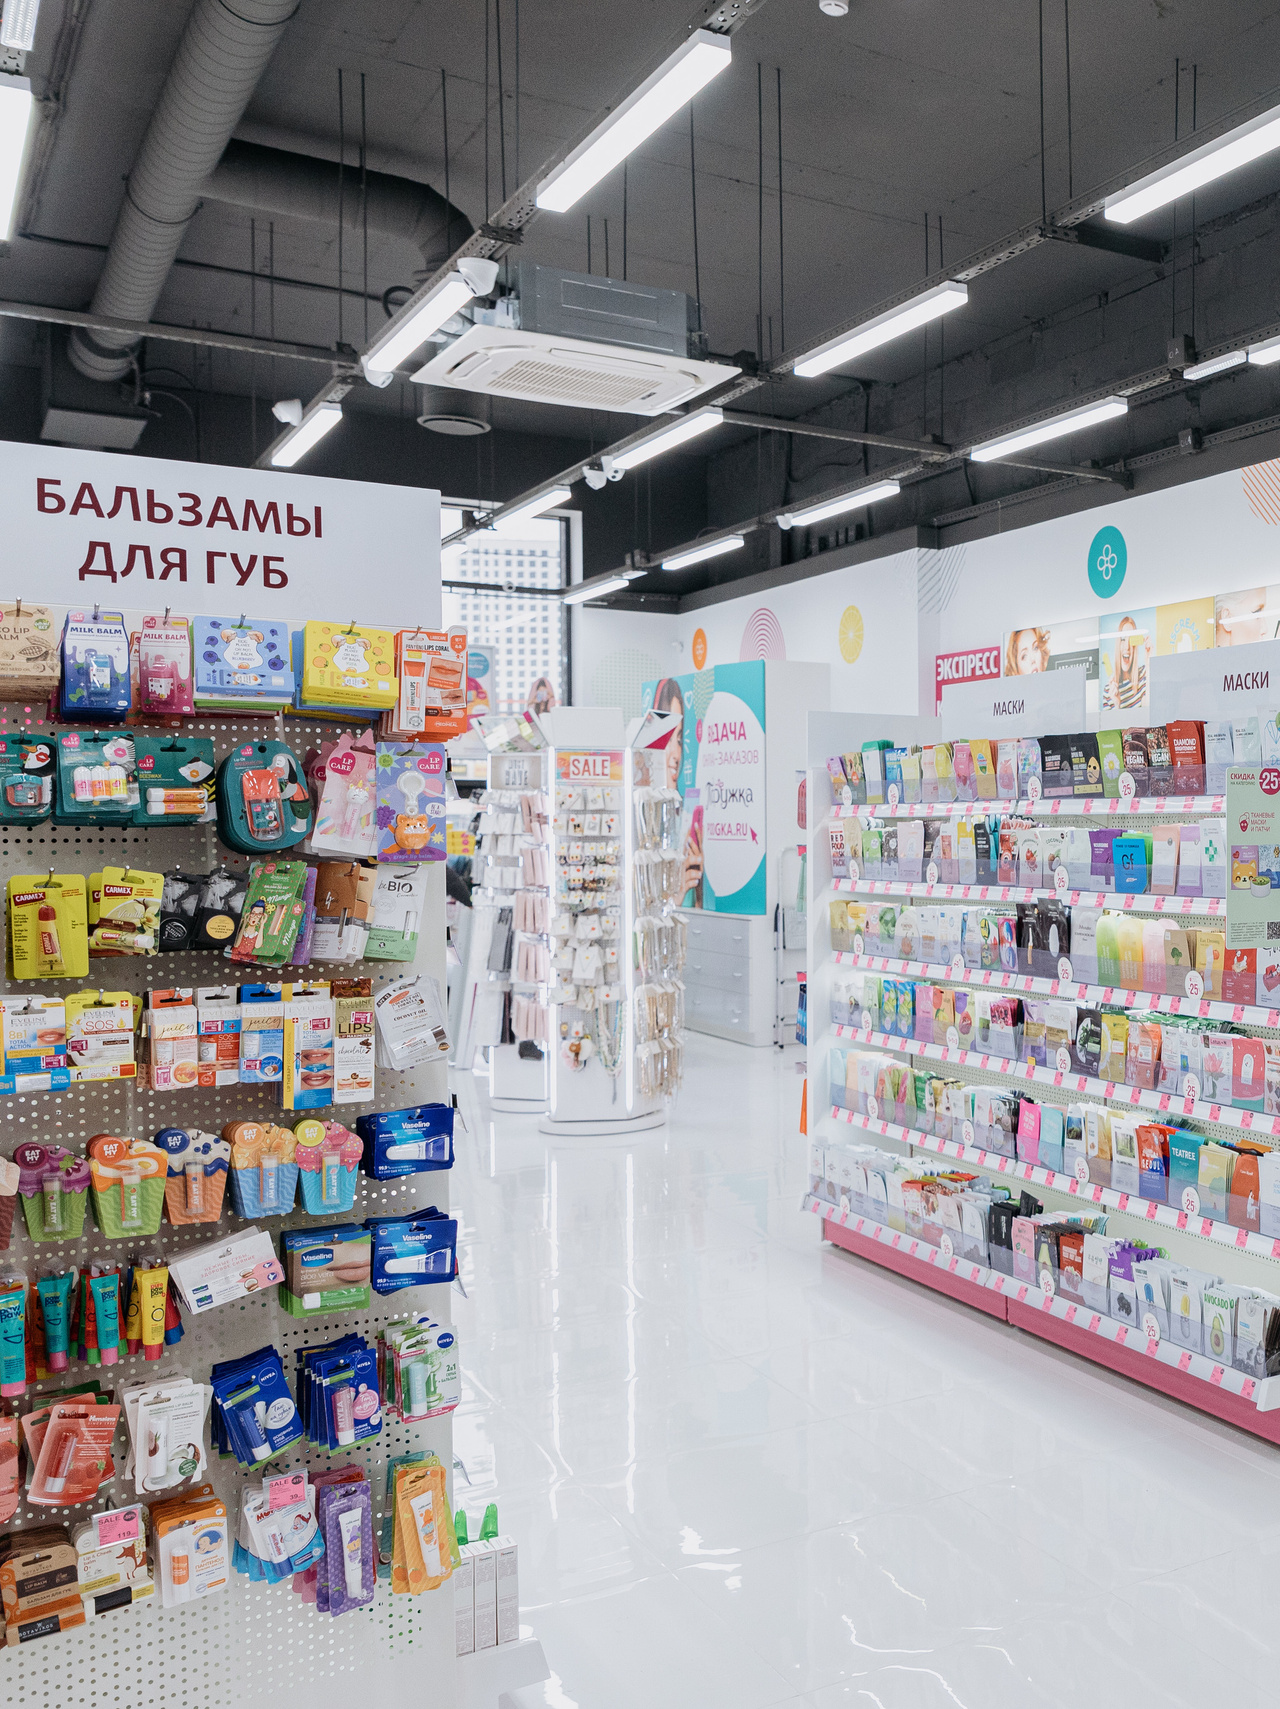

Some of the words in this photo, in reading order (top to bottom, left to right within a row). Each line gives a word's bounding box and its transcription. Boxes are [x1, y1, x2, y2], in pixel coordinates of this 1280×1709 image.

[36, 477, 324, 538] БАЛЬЗАМЫ
[78, 540, 188, 583] ДЛЯ
[206, 551, 289, 589] ГУБ
[70, 626, 94, 634] MILK
[937, 649, 999, 682] ЭКСПРЕСС
[1222, 671, 1270, 693] МАСКИ
[993, 699, 1025, 716] МАСКИ
[1173, 738, 1197, 746] DIAMOND
[1126, 755, 1144, 764] VEGAN
[1151, 754, 1170, 763] VEGAN
[330, 762, 352, 771] CARE
[571, 758, 610, 777] SALE
[1230, 773, 1256, 781] СКИДКА
[831, 842, 845, 850] FOOD
[1121, 852, 1134, 870] Gf
[105, 886, 132, 894] CARMEX
[378, 880, 413, 893] beBIO
[15, 892, 45, 902] CARMEX
[267, 893, 292, 903] Mango
[83, 1010, 115, 1018] EVELINE
[393, 1010, 418, 1021] COCONUT
[11, 1016, 47, 1025] EVELINE
[85, 1020, 114, 1031] SOS
[338, 1023, 372, 1034] LIPS
[338, 1046, 366, 1055] chocolate
[401, 1121, 431, 1129] Vaseline
[103, 1143, 119, 1151] EAT
[1171, 1147, 1196, 1161] TEATREE
[402, 1234, 432, 1242] Vaseline
[302, 1253, 333, 1262] Vaseline
[201, 1265, 231, 1278] ЗДОРОВОЕ
[232, 1255, 256, 1266] СИЯНИЕ
[204, 1259, 229, 1272] НЕЖНЫЕ
[300, 1272, 317, 1281] aloe
[1204, 1293, 1229, 1310] AVOCADO
[1, 1311, 21, 1323] paw
[357, 1360, 371, 1368] NIVEA
[260, 1371, 276, 1382] NIVEA
[269, 1479, 289, 1488] SALE
[98, 1516, 120, 1525] SALE
[96, 1549, 112, 1557] Cheek
[195, 1557, 224, 1569] ПАНТЕНОЛ
[35, 1580, 48, 1588] BALM
